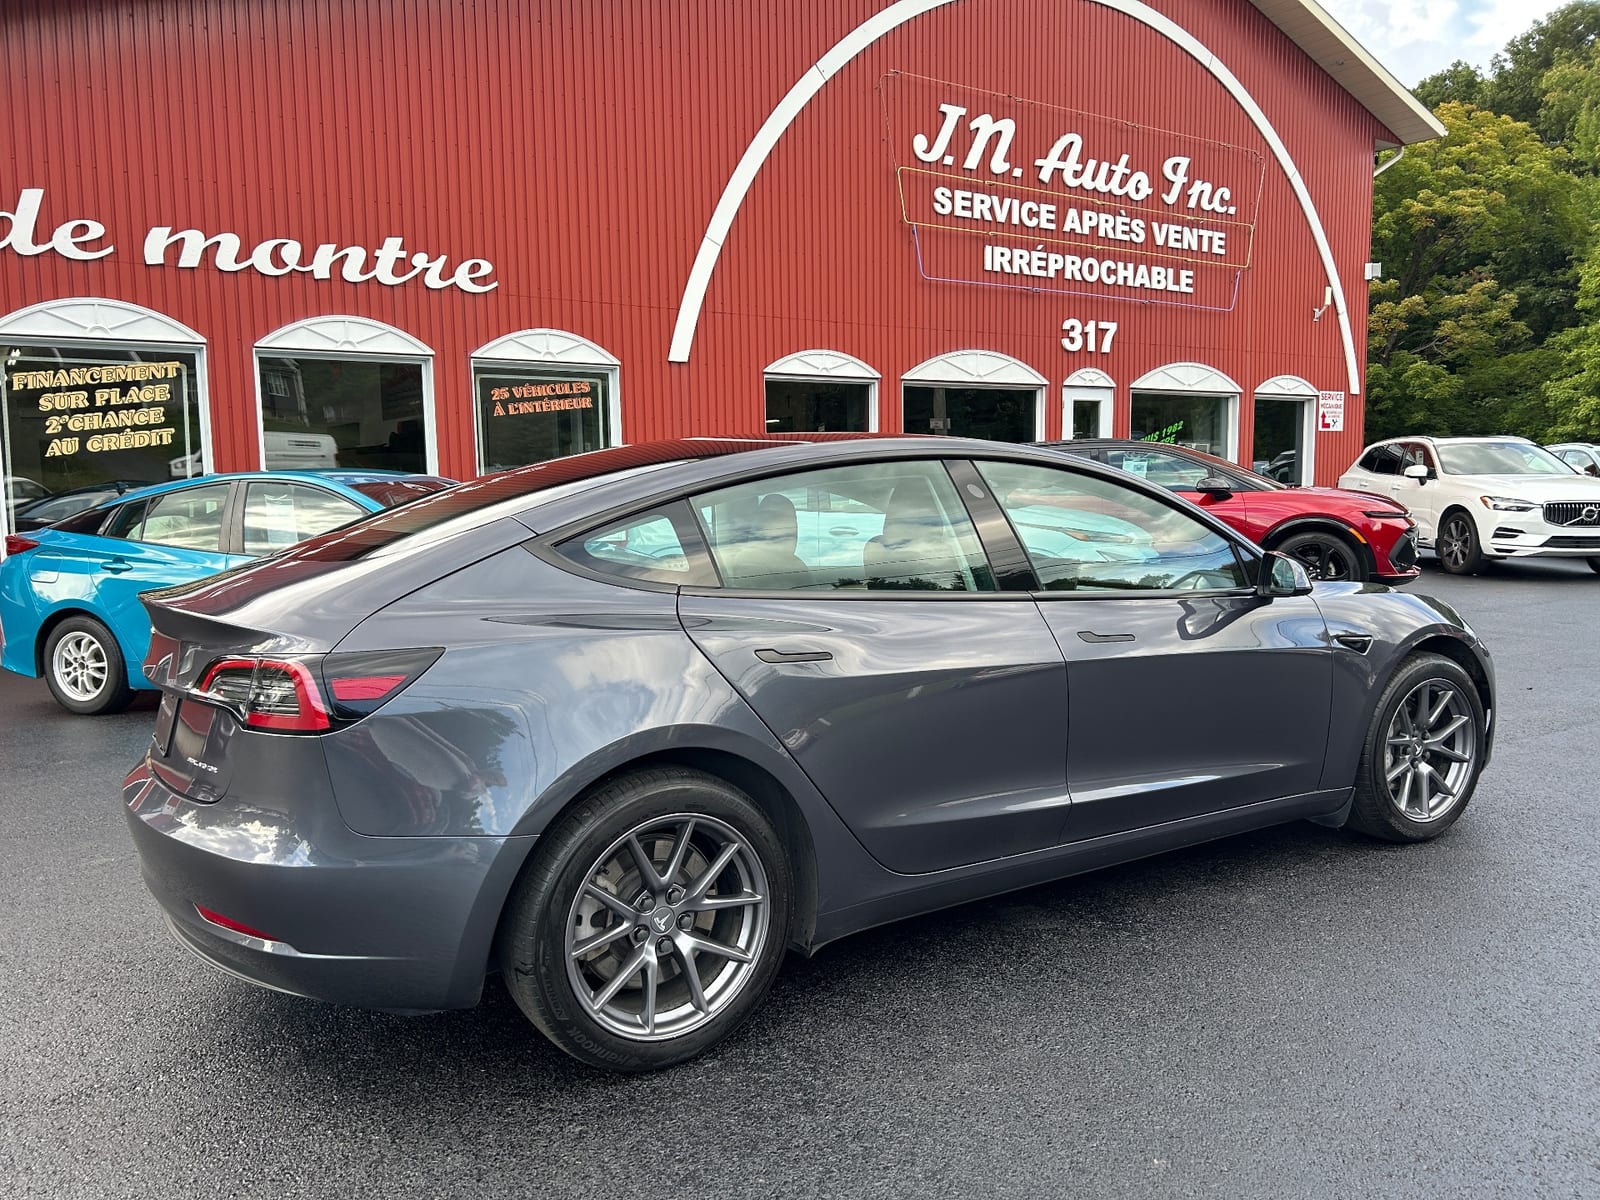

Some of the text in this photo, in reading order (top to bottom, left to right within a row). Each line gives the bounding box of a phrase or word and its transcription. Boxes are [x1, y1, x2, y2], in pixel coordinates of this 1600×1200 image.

[1034, 132, 1154, 201] Auto
[1161, 156, 1237, 215] Inc.
[933, 187, 1226, 255] SERVICE APRÈS VENTE
[143, 226, 499, 293] montre
[983, 244, 1194, 294] IRRÉPROCHABLE
[1061, 317, 1118, 353] 317
[12, 362, 180, 391] FINANCEMENT
[490, 382, 591, 401] 25 VÉHICULES
[39, 384, 170, 411] SUR PLACE
[493, 401, 506, 417] À
[45, 428, 175, 457] AU CRÉDIT
